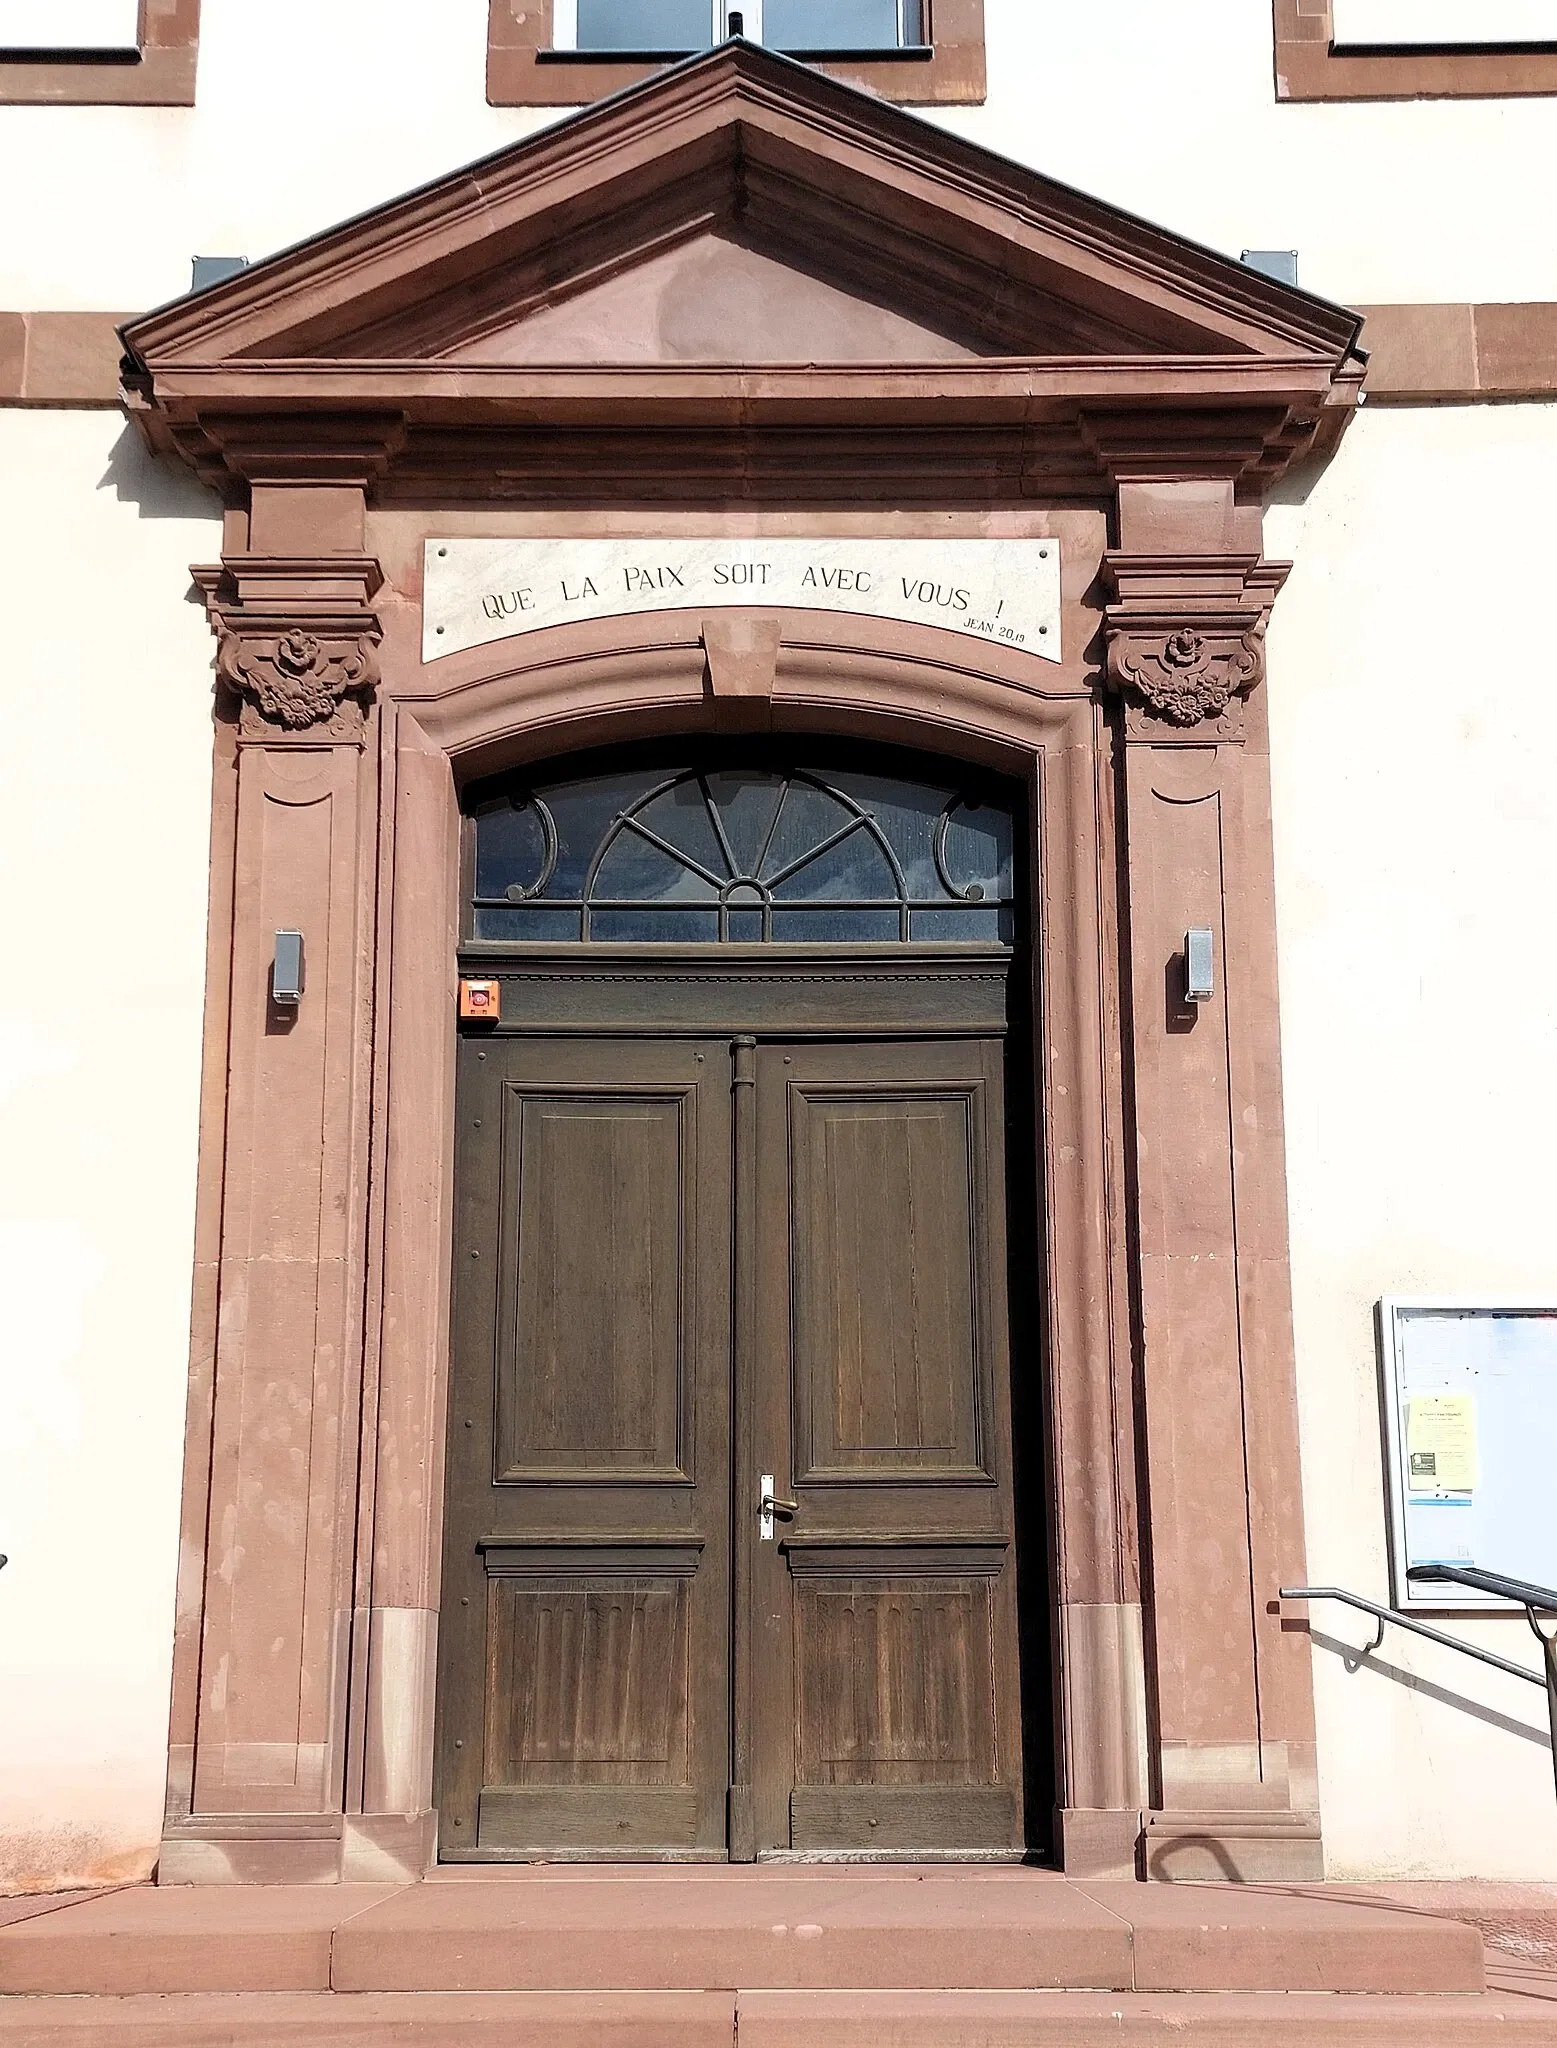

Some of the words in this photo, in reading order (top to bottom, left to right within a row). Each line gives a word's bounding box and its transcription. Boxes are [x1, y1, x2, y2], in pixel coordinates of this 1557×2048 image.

[482, 588, 536, 619] QUE
[561, 576, 599, 601] LA
[622, 566, 685, 592] PAIX
[713, 563, 772, 585] SOIT
[801, 566, 872, 593] AVEC
[902, 577, 971, 611] VOUS
[995, 599, 1004, 619] !
[963, 617, 994, 633] JEAN
